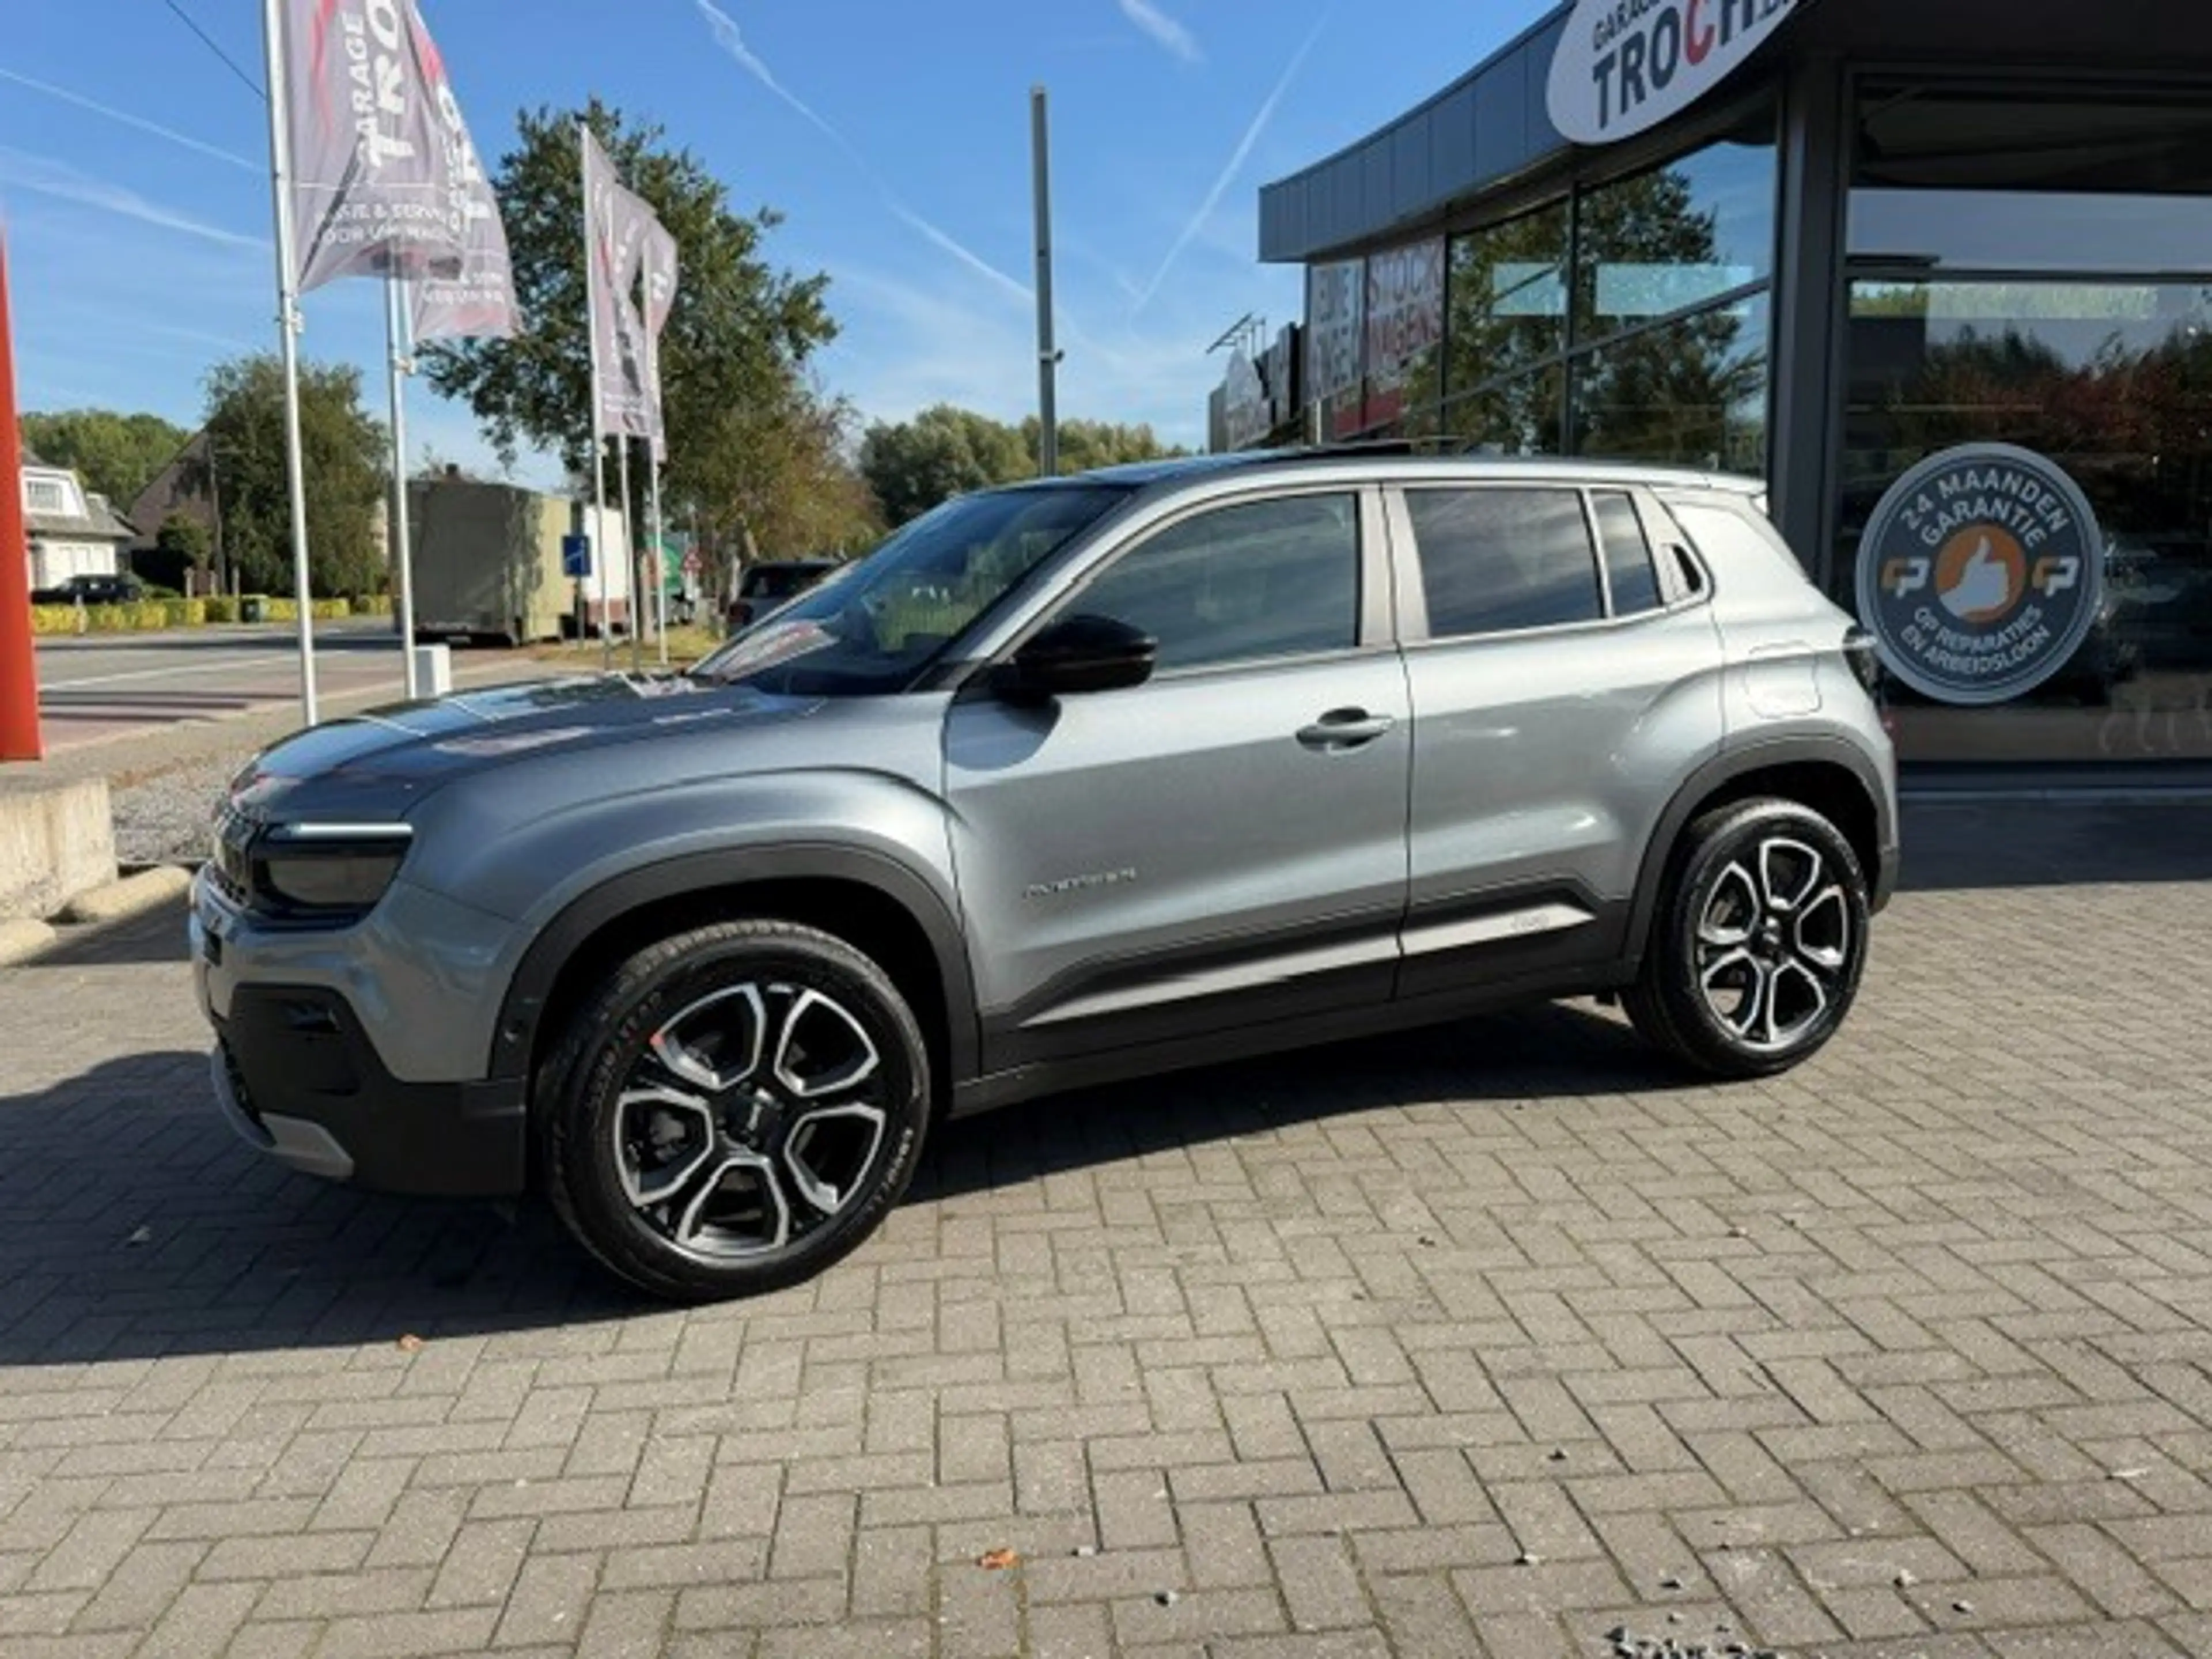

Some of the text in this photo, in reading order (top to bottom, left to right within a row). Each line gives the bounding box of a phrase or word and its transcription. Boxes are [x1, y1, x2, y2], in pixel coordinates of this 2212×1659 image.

[1901, 468, 2070, 533] 24 MAANDEN
[1921, 495, 2048, 548] GARANTIE
